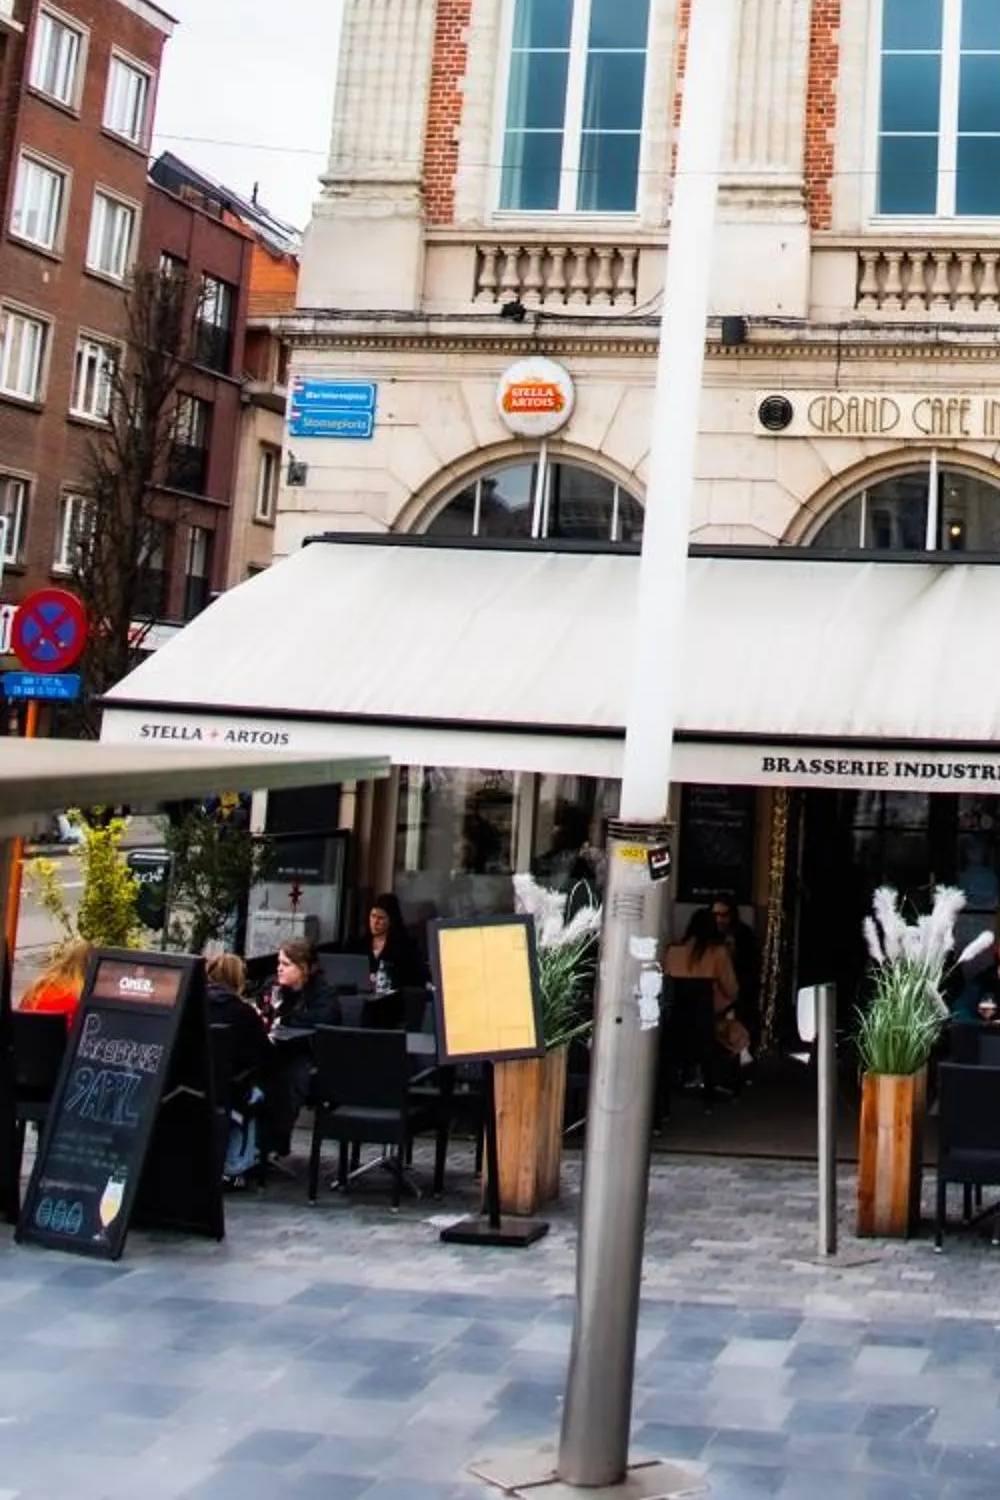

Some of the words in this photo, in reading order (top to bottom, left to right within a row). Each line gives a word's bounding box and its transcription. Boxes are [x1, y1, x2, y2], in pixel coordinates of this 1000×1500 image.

[511, 386, 555, 397] STELLA
[511, 397, 556, 407] ARTOIS
[807, 395, 901, 434] GRAND
[140, 723, 203, 741] STELLA
[224, 729, 289, 746] ARTOIS
[761, 756, 889, 778] BRASSERIE
